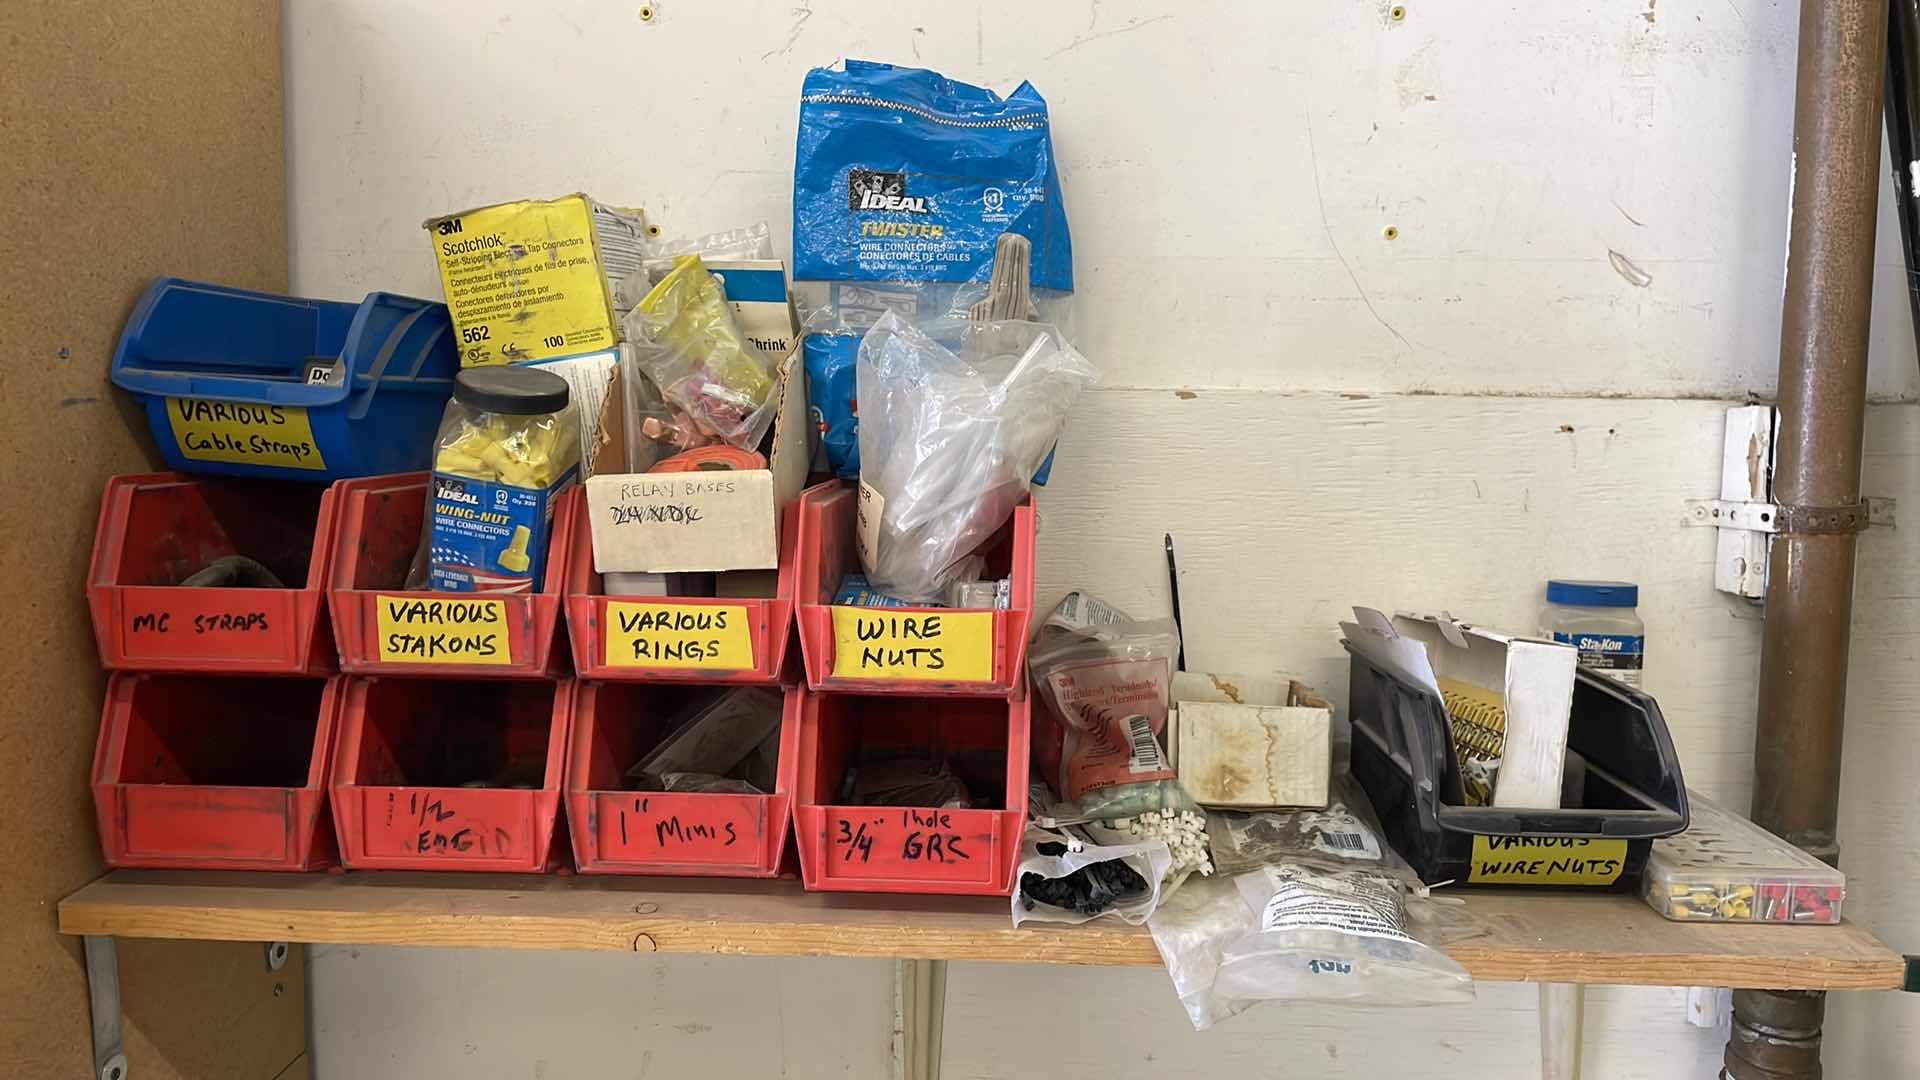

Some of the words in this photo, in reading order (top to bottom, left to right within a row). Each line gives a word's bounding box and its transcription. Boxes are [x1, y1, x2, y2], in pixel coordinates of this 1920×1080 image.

[860, 190, 928, 213] IDEAL
[438, 219, 463, 236] 3M
[863, 221, 944, 239] TWISTER
[442, 233, 503, 257] Scotchlok
[860, 243, 883, 252] WIRE
[446, 249, 493, 269] Self-Stripping
[527, 243, 541, 254] Tap
[860, 252, 920, 261] CONECTORES
[922, 253, 935, 261] DE
[937, 254, 971, 262] CABLES
[462, 326, 491, 344] 562
[543, 335, 564, 349] 100
[748, 338, 786, 351] hrink
[178, 399, 285, 425] VARIOUS
[184, 431, 246, 454] Cable
[249, 434, 312, 462] Straps
[437, 487, 479, 505] IDEAL
[621, 483, 674, 501] RELAY
[686, 482, 736, 496] BASES
[436, 504, 510, 525] WING-NUT
[435, 517, 456, 526] WIRE
[456, 520, 511, 536] CONNECTORS
[390, 600, 498, 622] VARIOUS
[133, 613, 170, 633] MC
[194, 612, 269, 633] STRAPS
[619, 610, 727, 634] VARIOUS
[857, 616, 942, 641] WIRE
[387, 634, 497, 656] STAKONS
[634, 638, 720, 661] RINGS
[1580, 637, 1622, 651] Sta-Kon
[862, 646, 945, 670] NUTS
[655, 815, 737, 847] Minis
[1481, 860, 1545, 876] WIRE
[1547, 857, 1620, 876] NUTS
